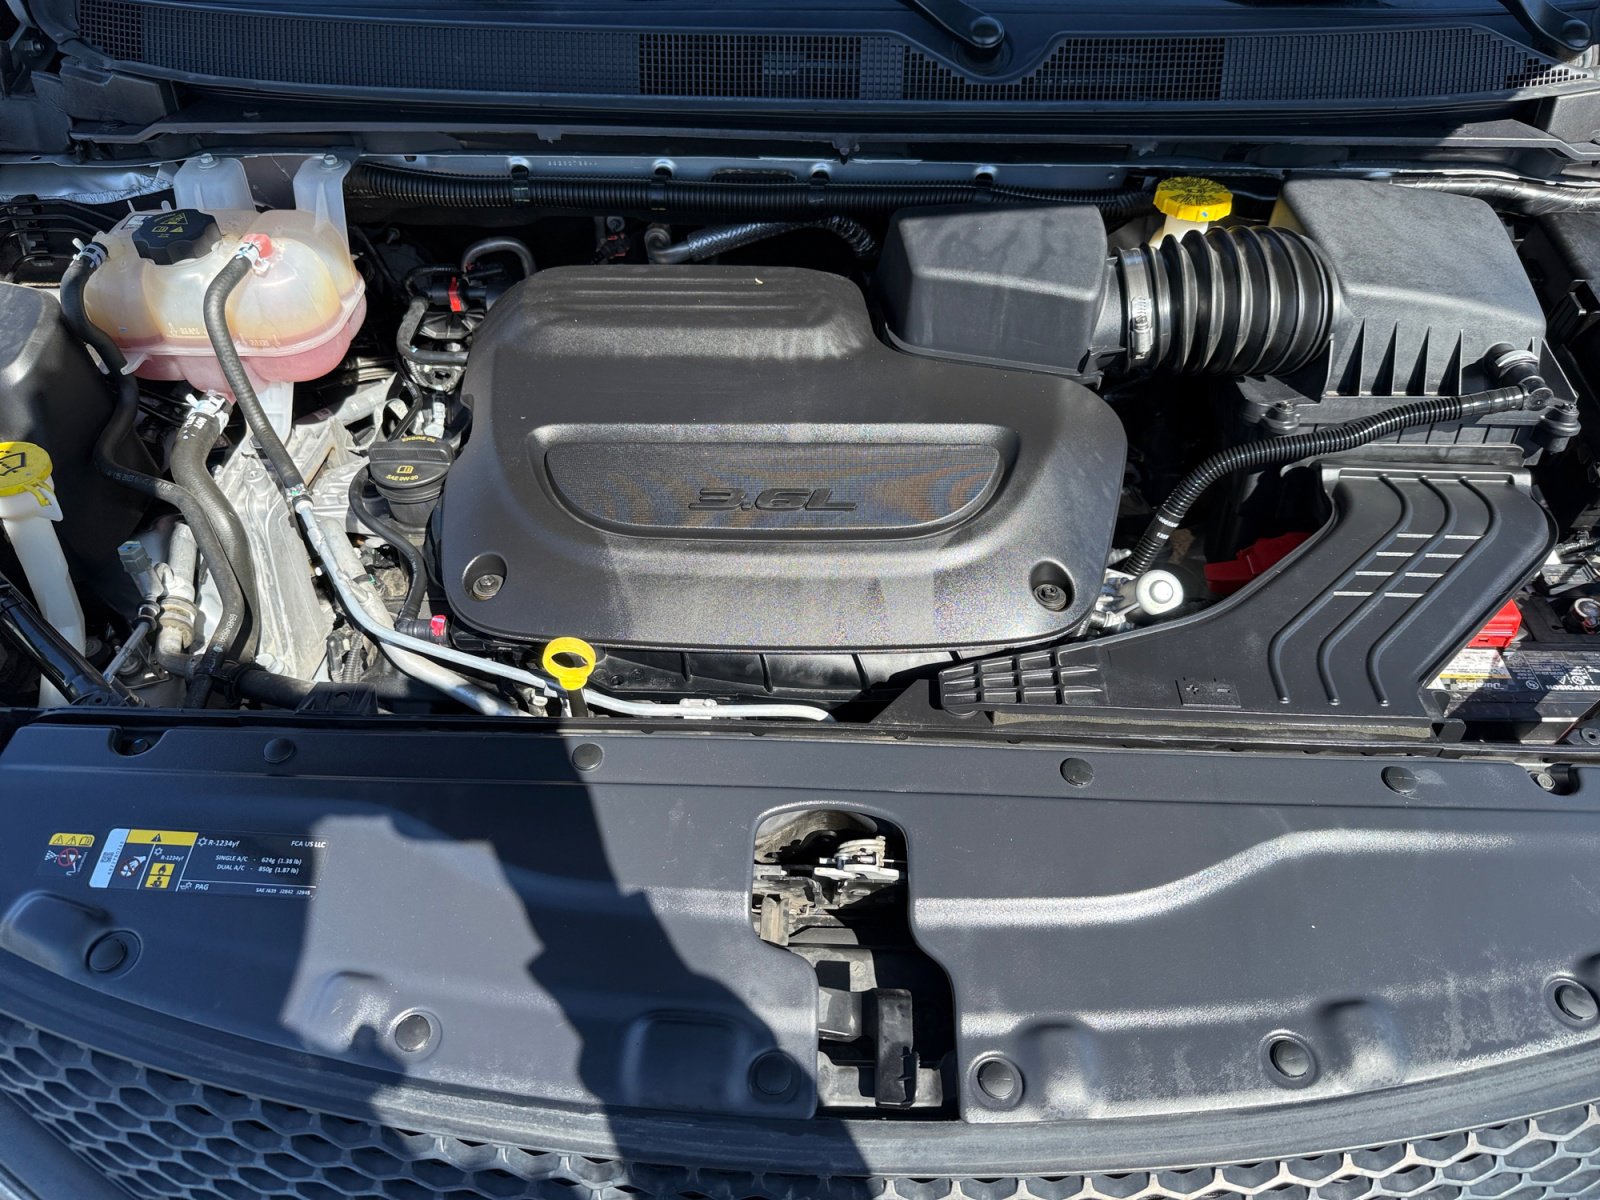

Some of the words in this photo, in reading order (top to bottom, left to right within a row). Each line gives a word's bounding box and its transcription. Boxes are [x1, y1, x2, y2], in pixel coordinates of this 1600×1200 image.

[688, 487, 858, 512] 3.6L
[208, 839, 240, 848] R-1234yf
[314, 841, 327, 849] LLC
[215, 854, 236, 862] SINGLE
[277, 857, 293, 865] (1.38
[293, 858, 302, 866] lb)
[216, 863, 233, 871] DUAL
[258, 866, 273, 874] 850g
[274, 866, 290, 874] (1.87
[290, 867, 299, 875] lb)
[194, 883, 210, 891] PAG
